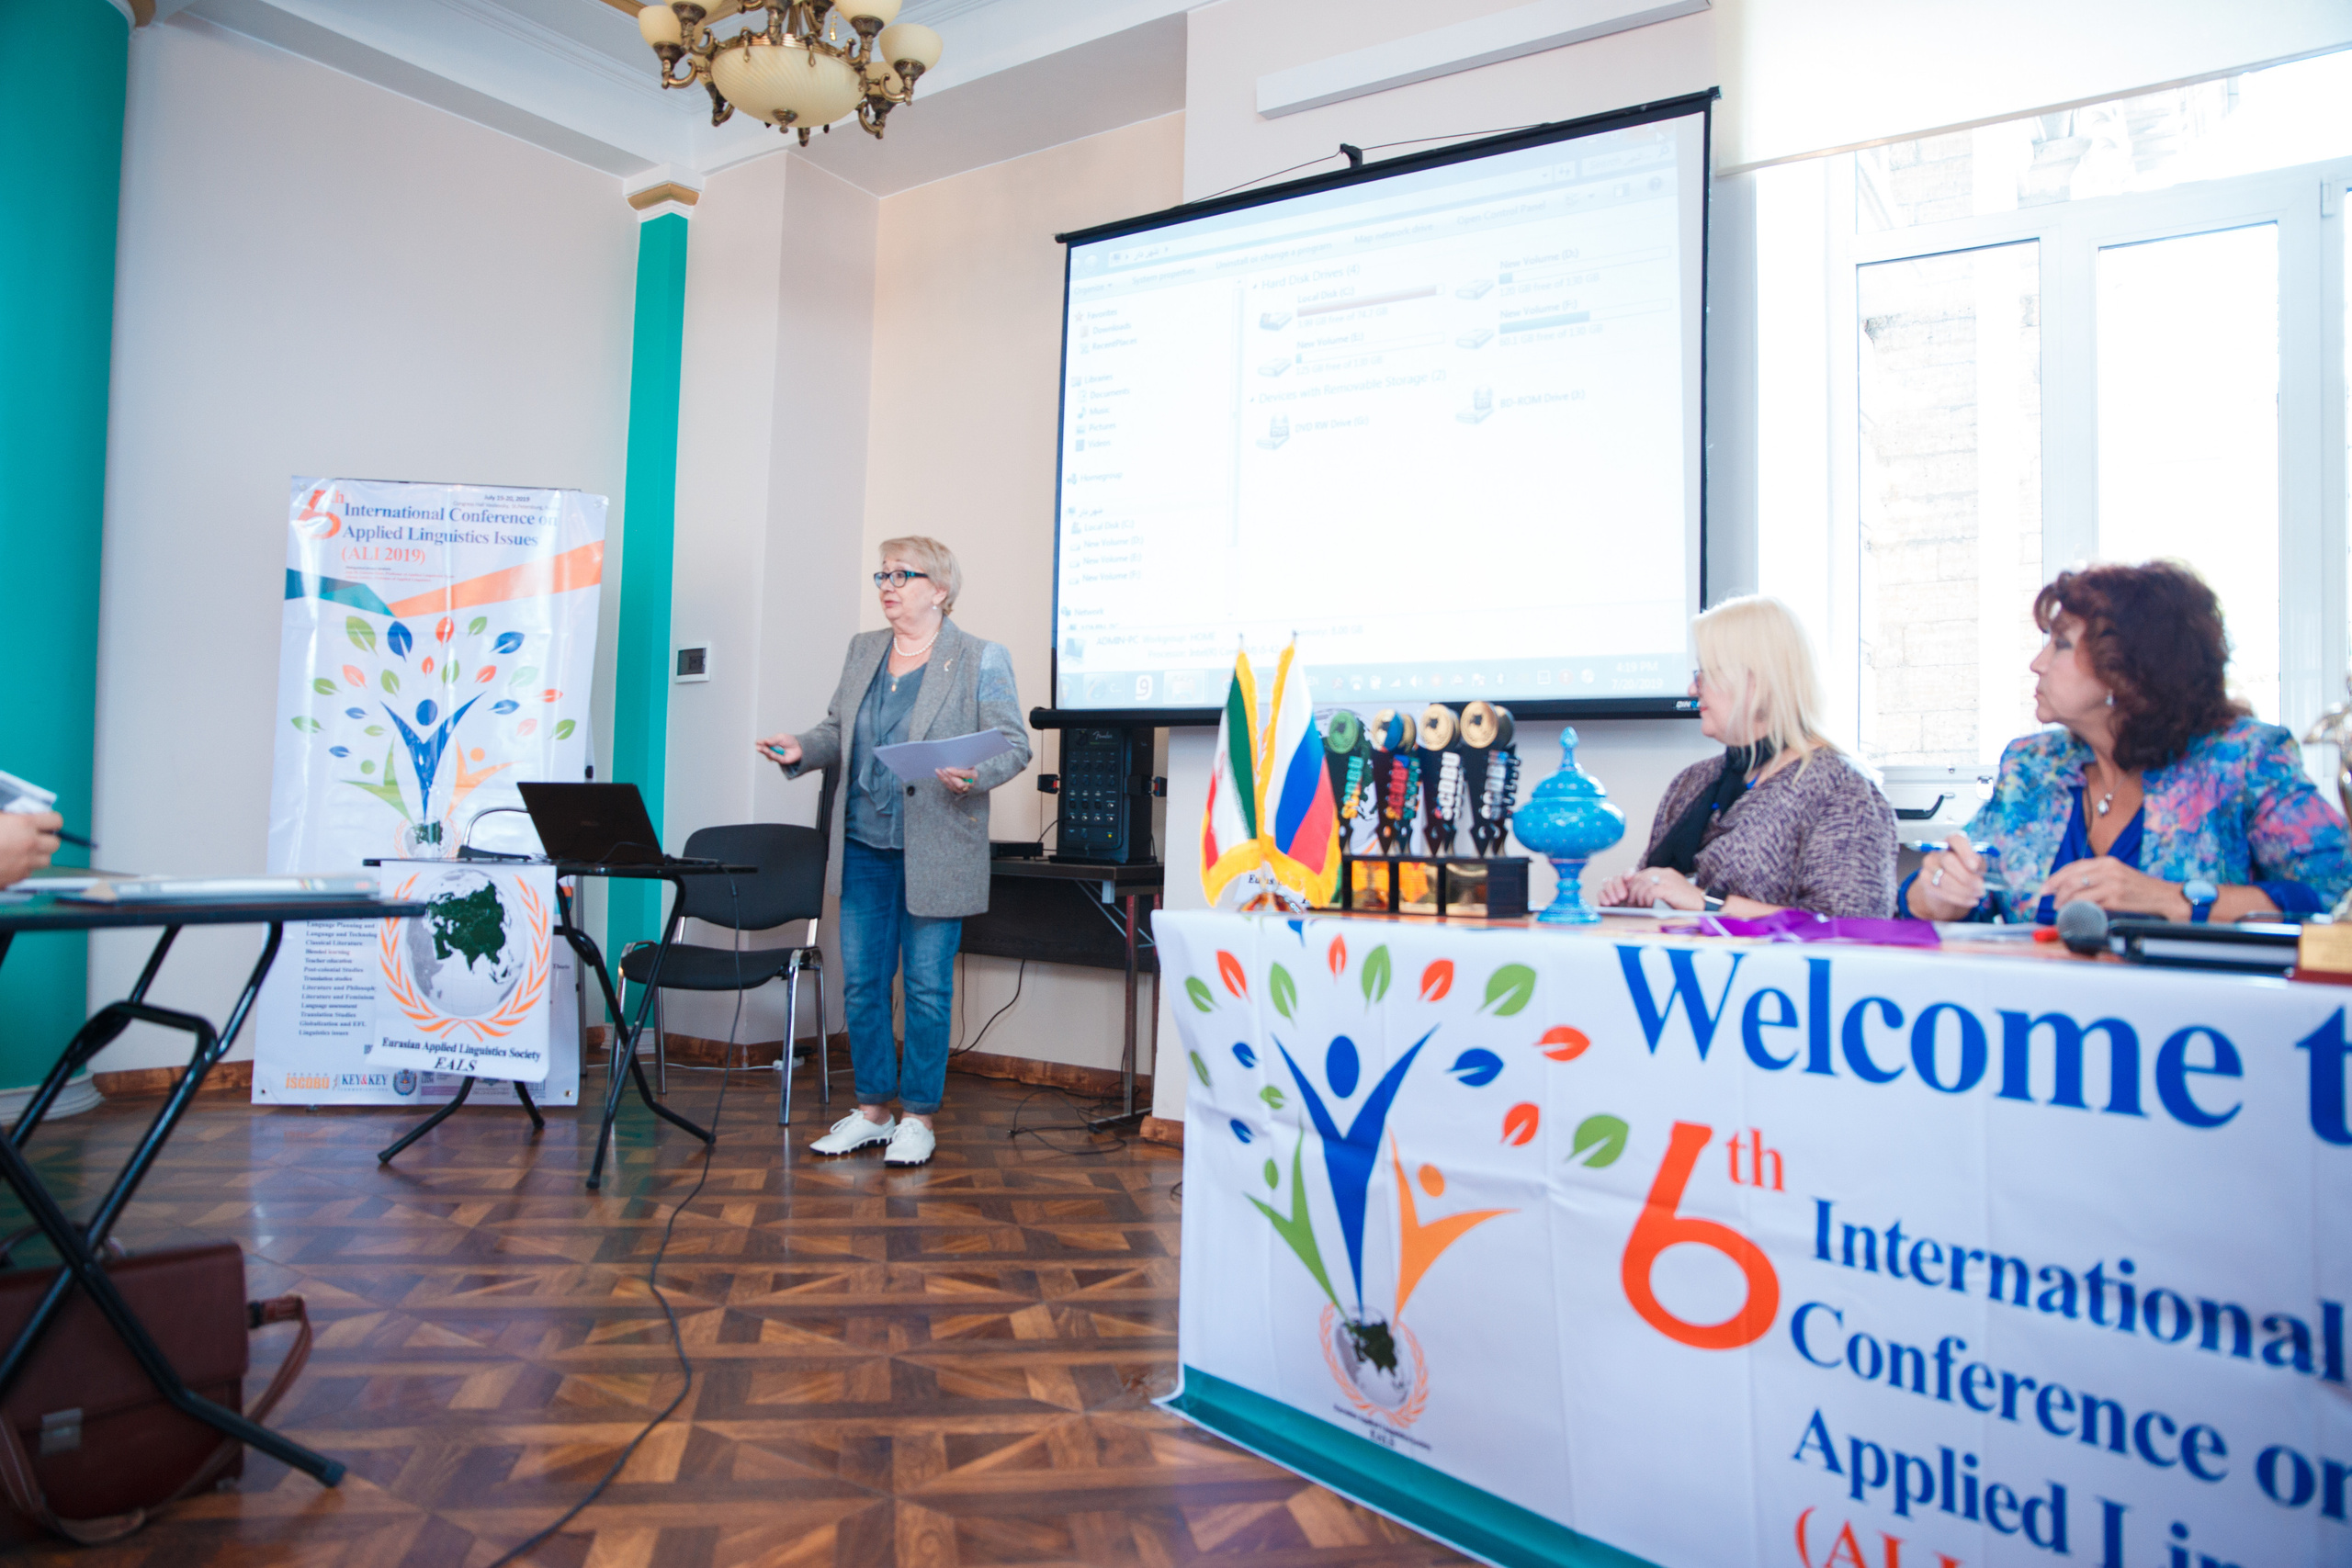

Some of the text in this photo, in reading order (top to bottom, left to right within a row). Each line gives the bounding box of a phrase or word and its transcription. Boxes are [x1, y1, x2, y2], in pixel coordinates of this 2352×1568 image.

[1375, 227, 1410, 241] network
[1499, 259, 1521, 270] New
[1522, 253, 1560, 266] Volume
[1261, 264, 1361, 289] Hard Disk Drives (4)
[1297, 290, 1318, 304] Local
[1320, 287, 1339, 300] Disk
[1087, 308, 1117, 320] Favorites
[1499, 309, 1521, 321] New
[1522, 302, 1560, 316] Volume
[1092, 322, 1131, 334] Downloads
[1296, 340, 1315, 351] New
[1317, 335, 1349, 347] Volume
[1084, 373, 1114, 384] Libraries
[1090, 388, 1131, 399] Documents
[1259, 369, 1447, 404] Devices with Removable Storage (2)
[1499, 394, 1542, 408] BD-ROM
[1544, 390, 1569, 404] Drive
[1090, 406, 1110, 415] Music
[1089, 422, 1116, 432] Pictures
[1295, 421, 1313, 433] DVD
[1330, 417, 1351, 430] Drive
[1088, 438, 1112, 448] Videos
[1080, 471, 1124, 485] Homegroup
[344, 502, 558, 527] International Conference on
[1084, 521, 1102, 532] Local
[1104, 519, 1119, 530] Disk
[343, 525, 538, 547] Applied Linguistics Issues
[1083, 539, 1100, 549] New
[1102, 536, 1129, 547] Volume
[341, 547, 426, 565] (ALI 2019)
[1082, 556, 1100, 566] New
[1101, 553, 1128, 565] Volume
[1081, 573, 1098, 583] New
[1100, 570, 1127, 581] Volume
[1074, 606, 1104, 616] Network
[1097, 634, 1139, 646] ADMIN-PC
[1640, 660, 1658, 672] PM
[349, 931, 378, 939] Technolog
[1614, 943, 2245, 1130] Welcome
[382, 1036, 421, 1050] Eurasian
[424, 1041, 457, 1055] Applied
[459, 1043, 506, 1057] Linguistics
[509, 1047, 541, 1061] Society
[434, 1055, 478, 1072] EALS
[341, 1073, 389, 1086] KEY&KEY
[1810, 1196, 2351, 1384] International
[1790, 1301, 2231, 1483] Conference
[1791, 1407, 2074, 1558] Applied
